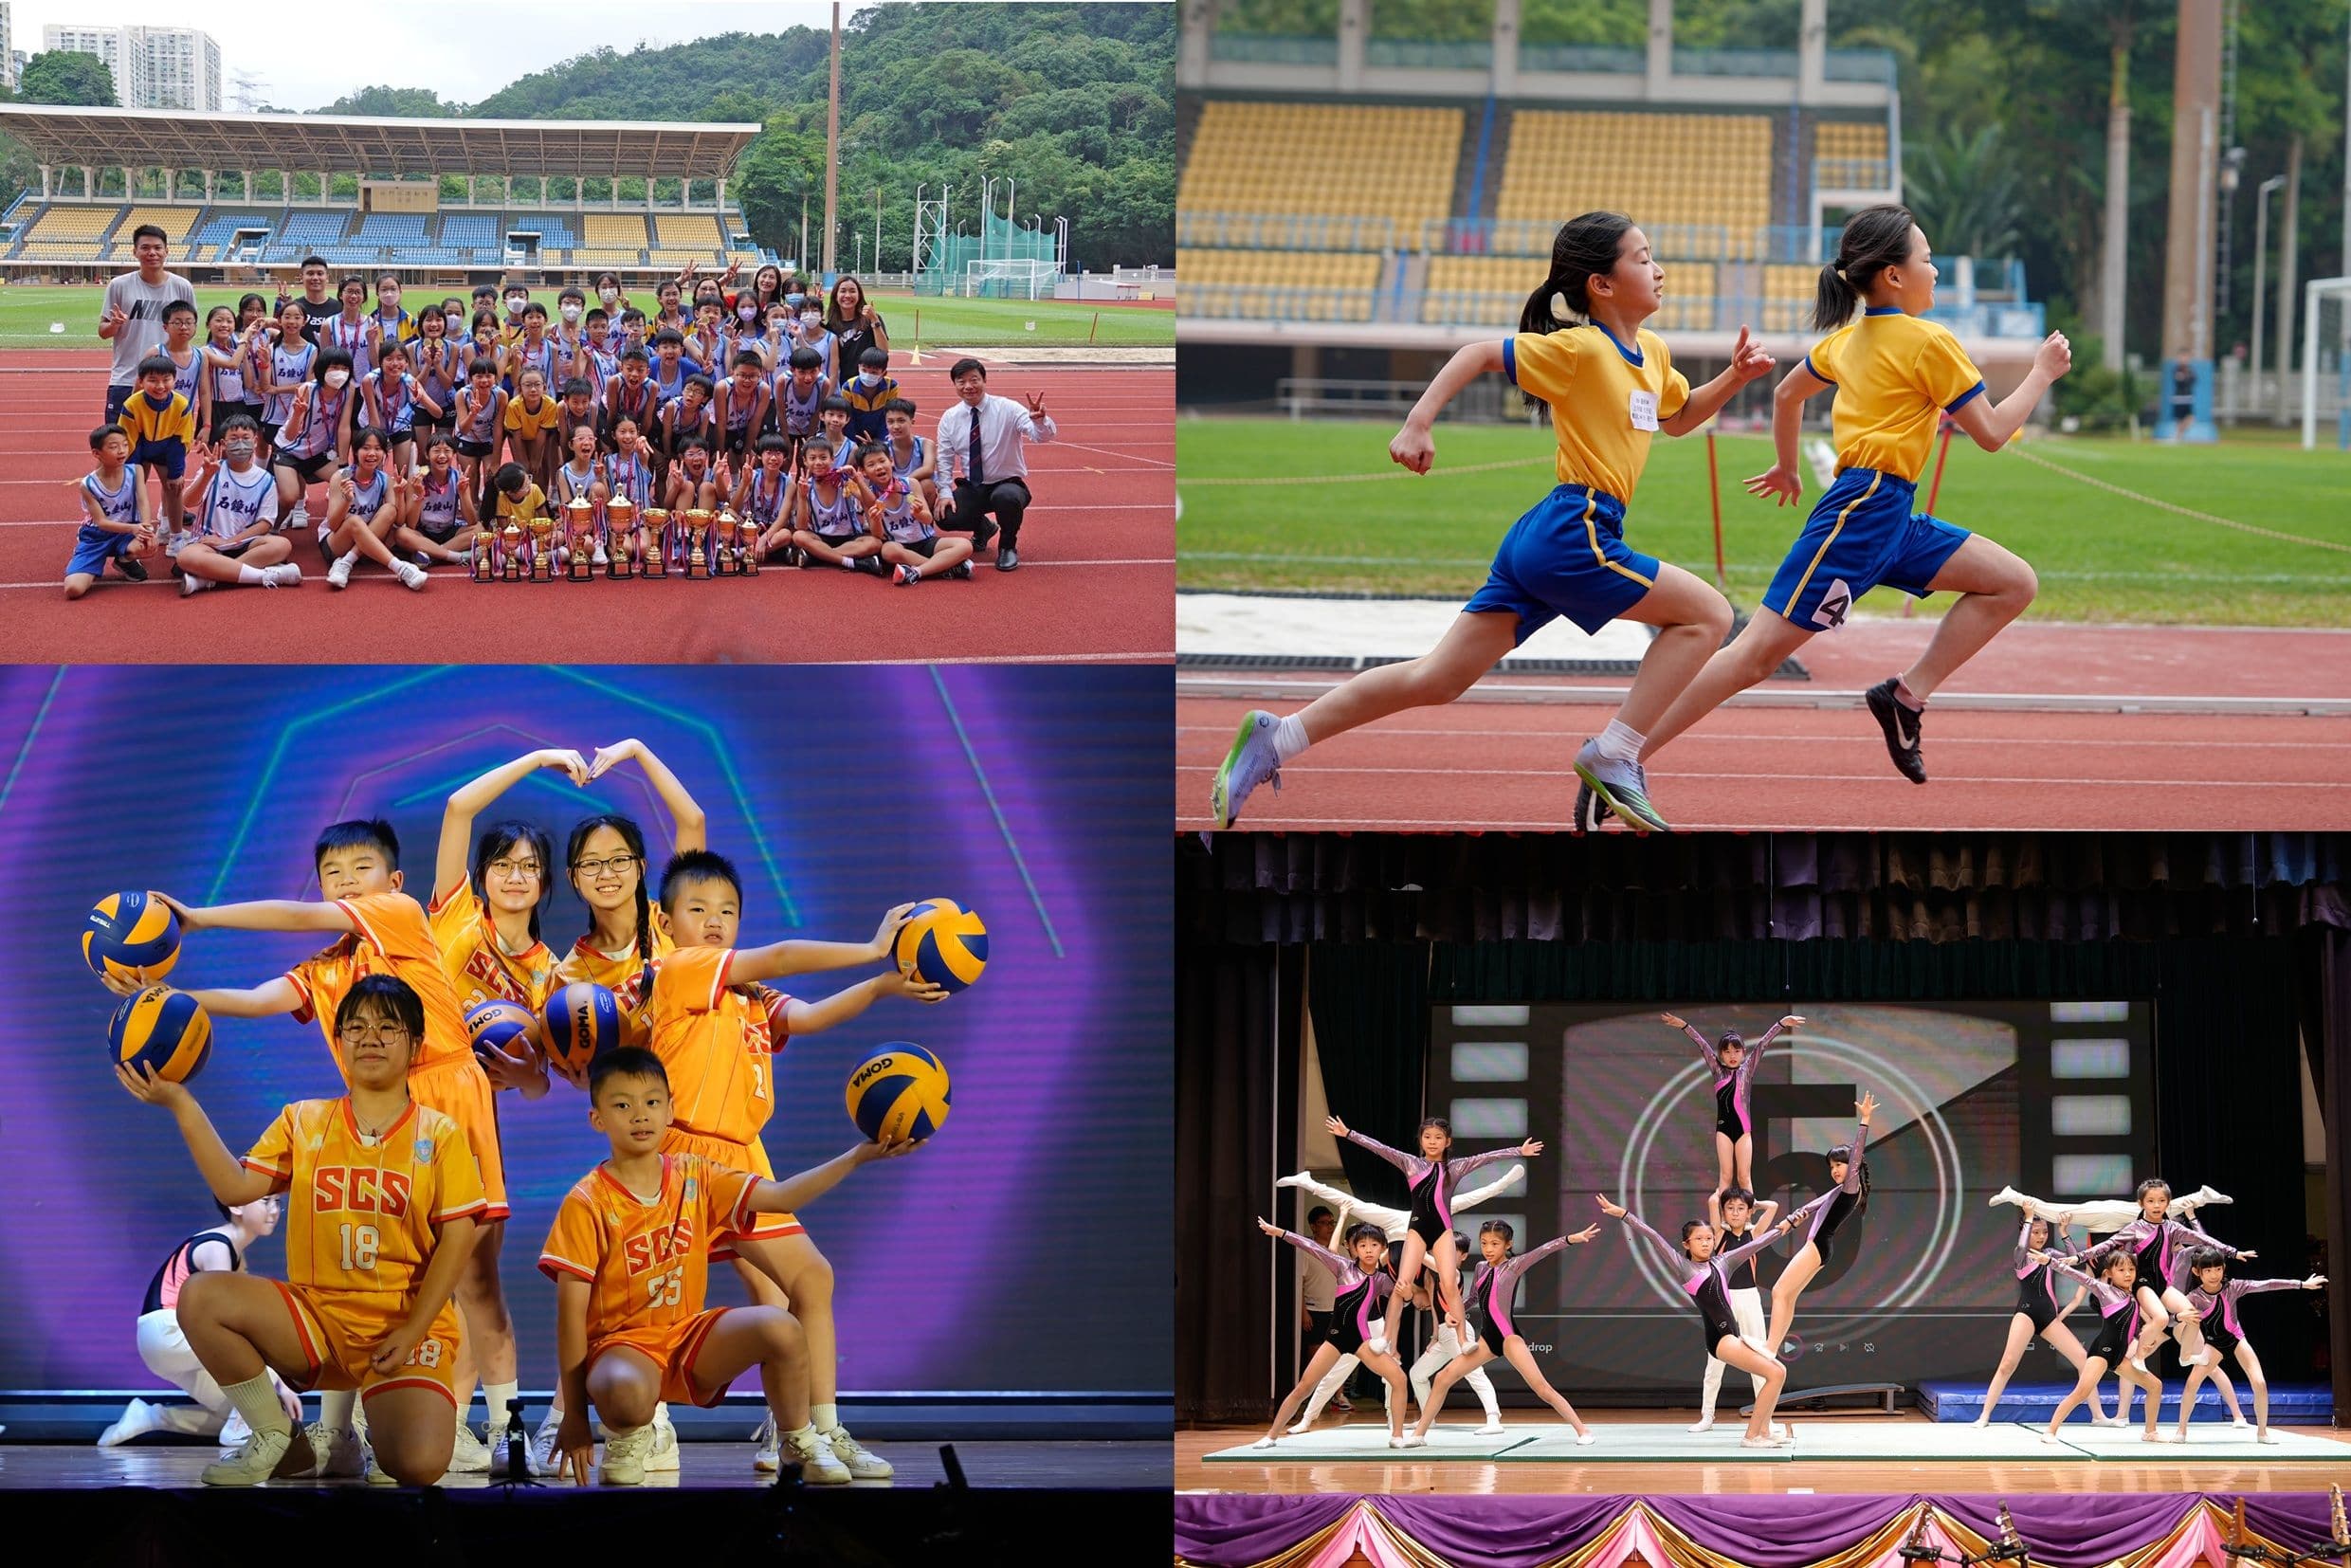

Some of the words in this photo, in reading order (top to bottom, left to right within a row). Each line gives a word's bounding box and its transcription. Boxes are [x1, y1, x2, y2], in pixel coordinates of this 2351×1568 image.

[129, 299, 163, 320] NIK
[216, 496, 257, 516] 石鐘山
[1819, 594, 1850, 627] 4
[577, 1005, 591, 1049] GOMA
[853, 1058, 893, 1087] GOMA
[314, 1166, 412, 1220] SCS
[339, 1222, 380, 1271] 18
[624, 1216, 693, 1277] SCS
